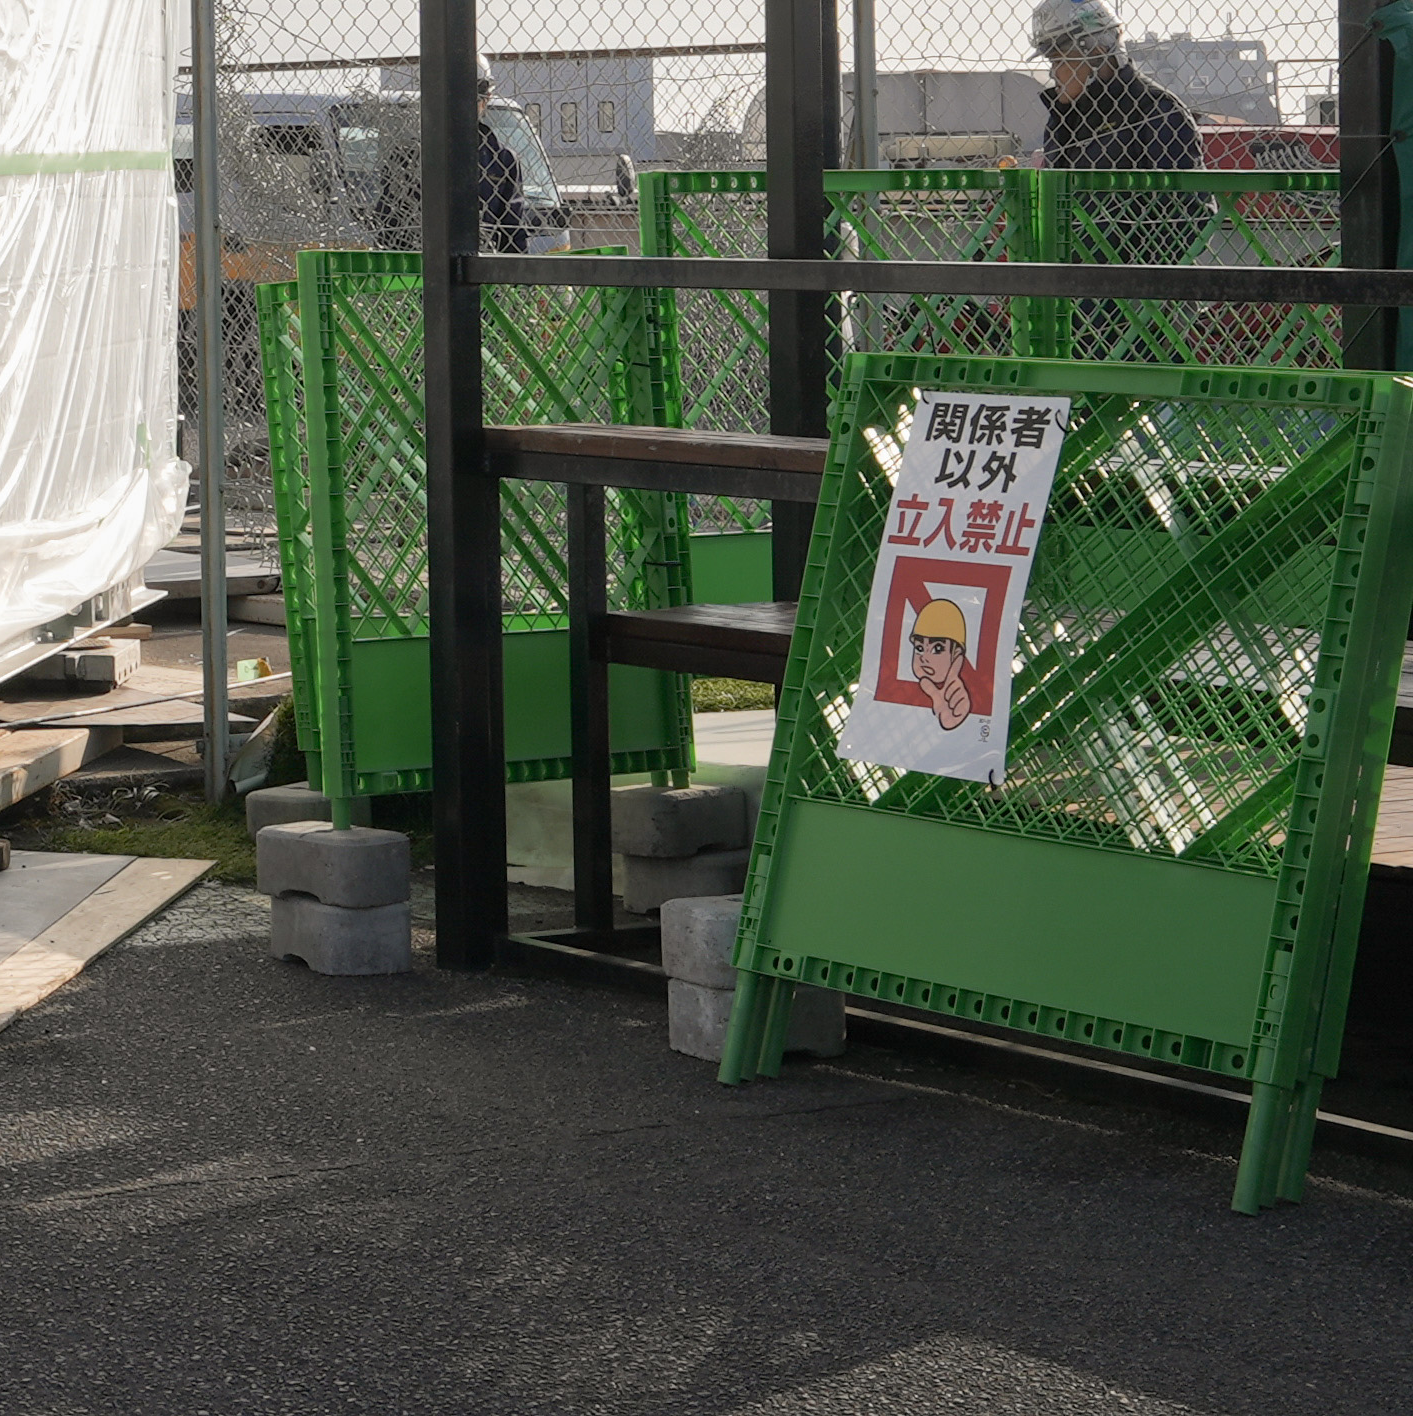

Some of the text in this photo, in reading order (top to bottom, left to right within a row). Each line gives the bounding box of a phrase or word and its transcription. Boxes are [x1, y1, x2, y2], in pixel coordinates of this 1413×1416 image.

[925, 403, 1051, 449] 関係者
[934, 447, 1018, 493] 以外
[887, 493, 1036, 557] 立入禁止
